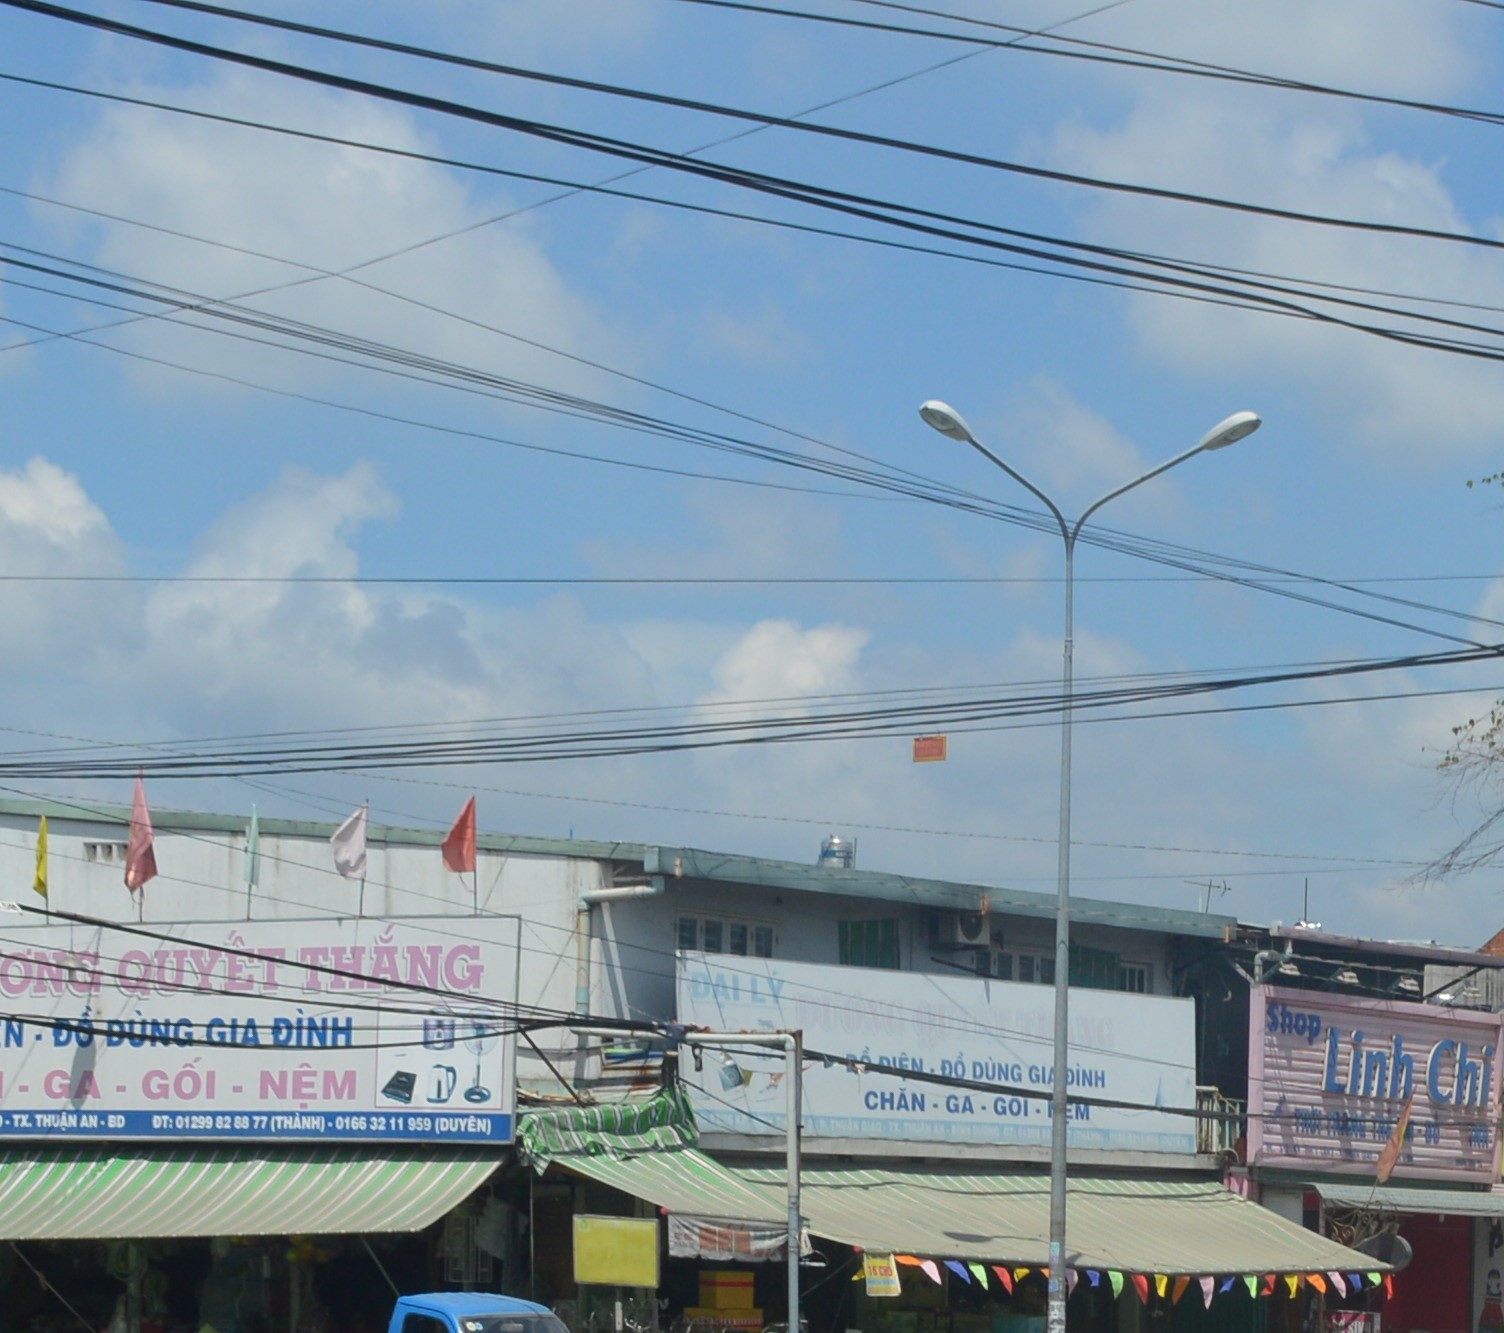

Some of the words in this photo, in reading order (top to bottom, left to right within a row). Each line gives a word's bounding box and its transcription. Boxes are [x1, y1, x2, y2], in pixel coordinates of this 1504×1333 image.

[116, 929, 287, 998] QUYẾT
[298, 923, 484, 993] THẮNG
[205, 1016, 261, 1049] GIA
[272, 1008, 354, 1048] ĐÌNH
[1266, 1001, 1322, 1046] Shop
[43, 1069, 101, 1101] GA
[141, 1057, 217, 1101] GỐI
[259, 1062, 357, 1110] NỆM
[972, 1056, 1023, 1083] DÙNG
[1322, 1026, 1414, 1100] Linh
[1426, 1038, 1495, 1107] Chi
[36, 1112, 78, 1132] THUẬN
[79, 1116, 99, 1129] AN
[252, 1116, 269, 1130] 77
[864, 1087, 926, 1113] CHĂN
[945, 1093, 975, 1115] GA
